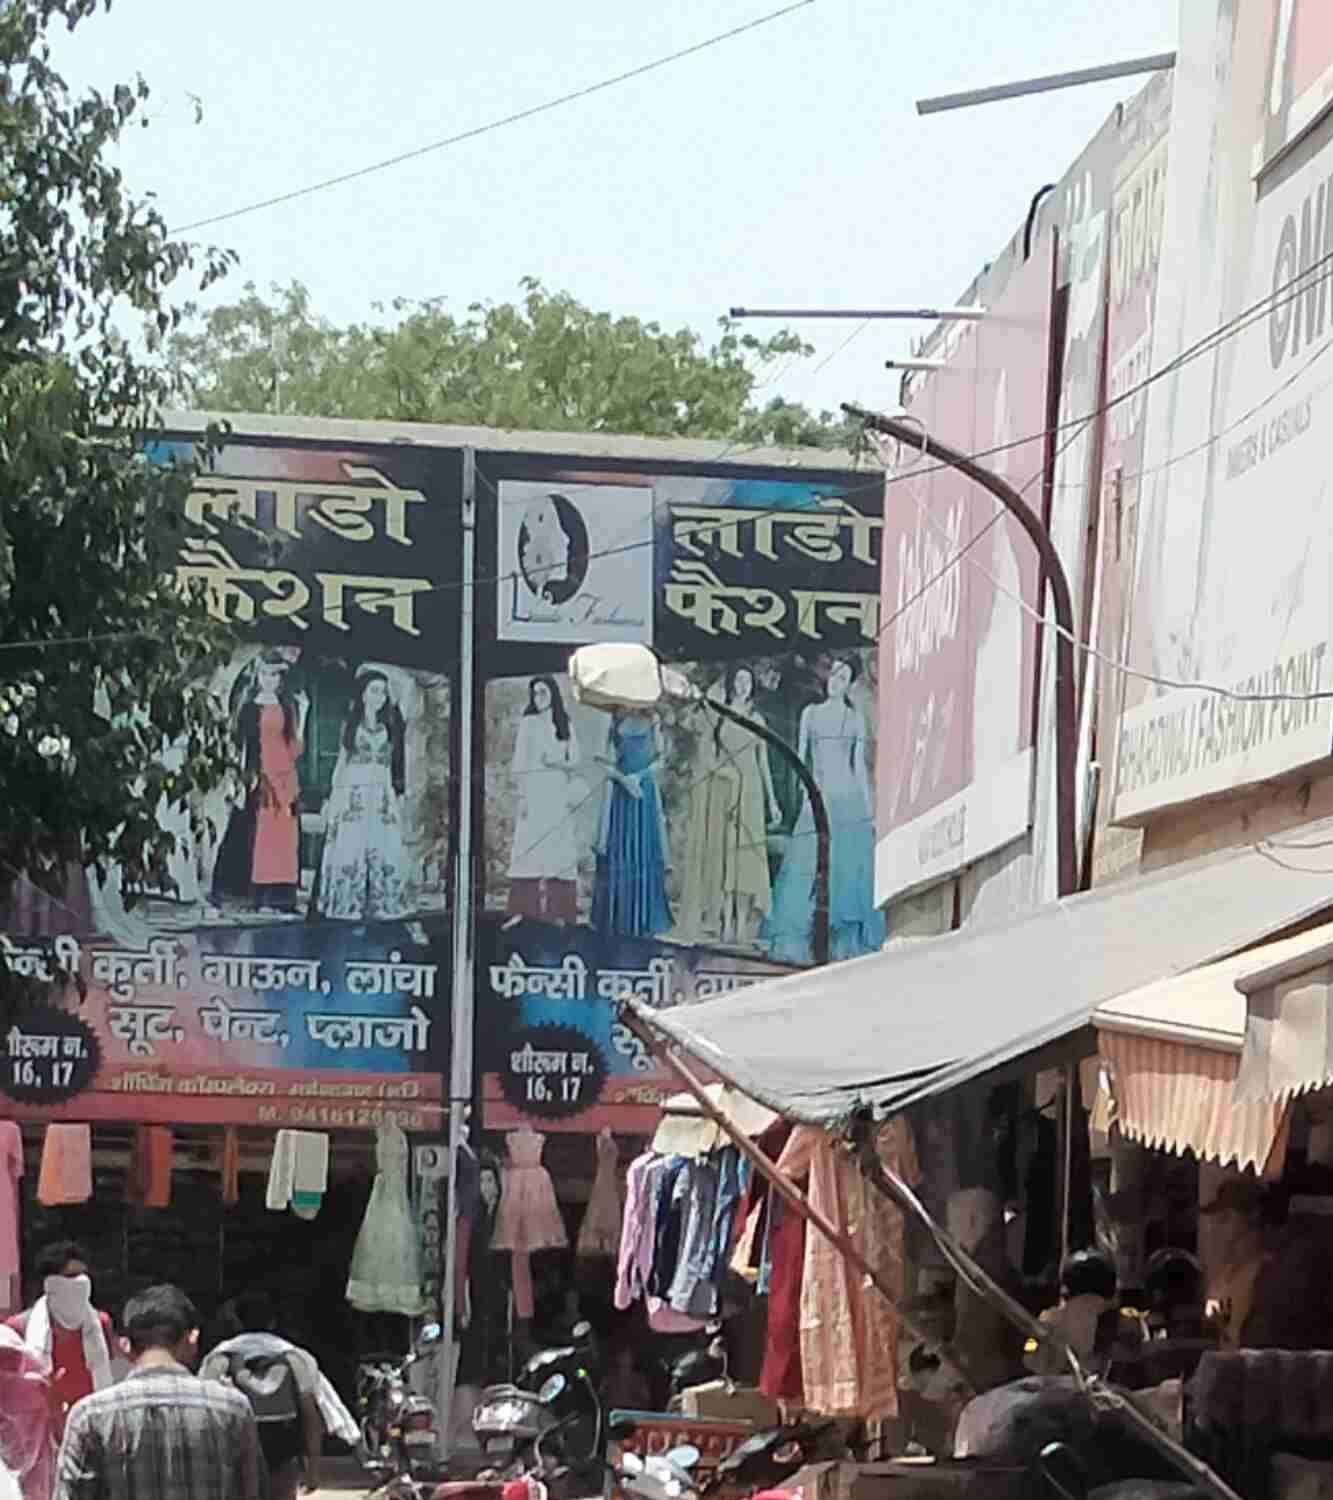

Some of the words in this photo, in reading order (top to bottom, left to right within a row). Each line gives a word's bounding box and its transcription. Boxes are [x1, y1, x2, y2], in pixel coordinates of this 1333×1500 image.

[186, 465, 428, 546] लाडो
[670, 495, 884, 567] लाडो
[178, 539, 432, 636] फैशन
[666, 573, 881, 641] फैशन
[305, 1005, 431, 1051] प्लाजो
[12, 1059, 43, 1088] 16,
[50, 1061, 75, 1088] 17
[525, 1075, 553, 1102] 16,
[560, 1075, 582, 1102] 17
